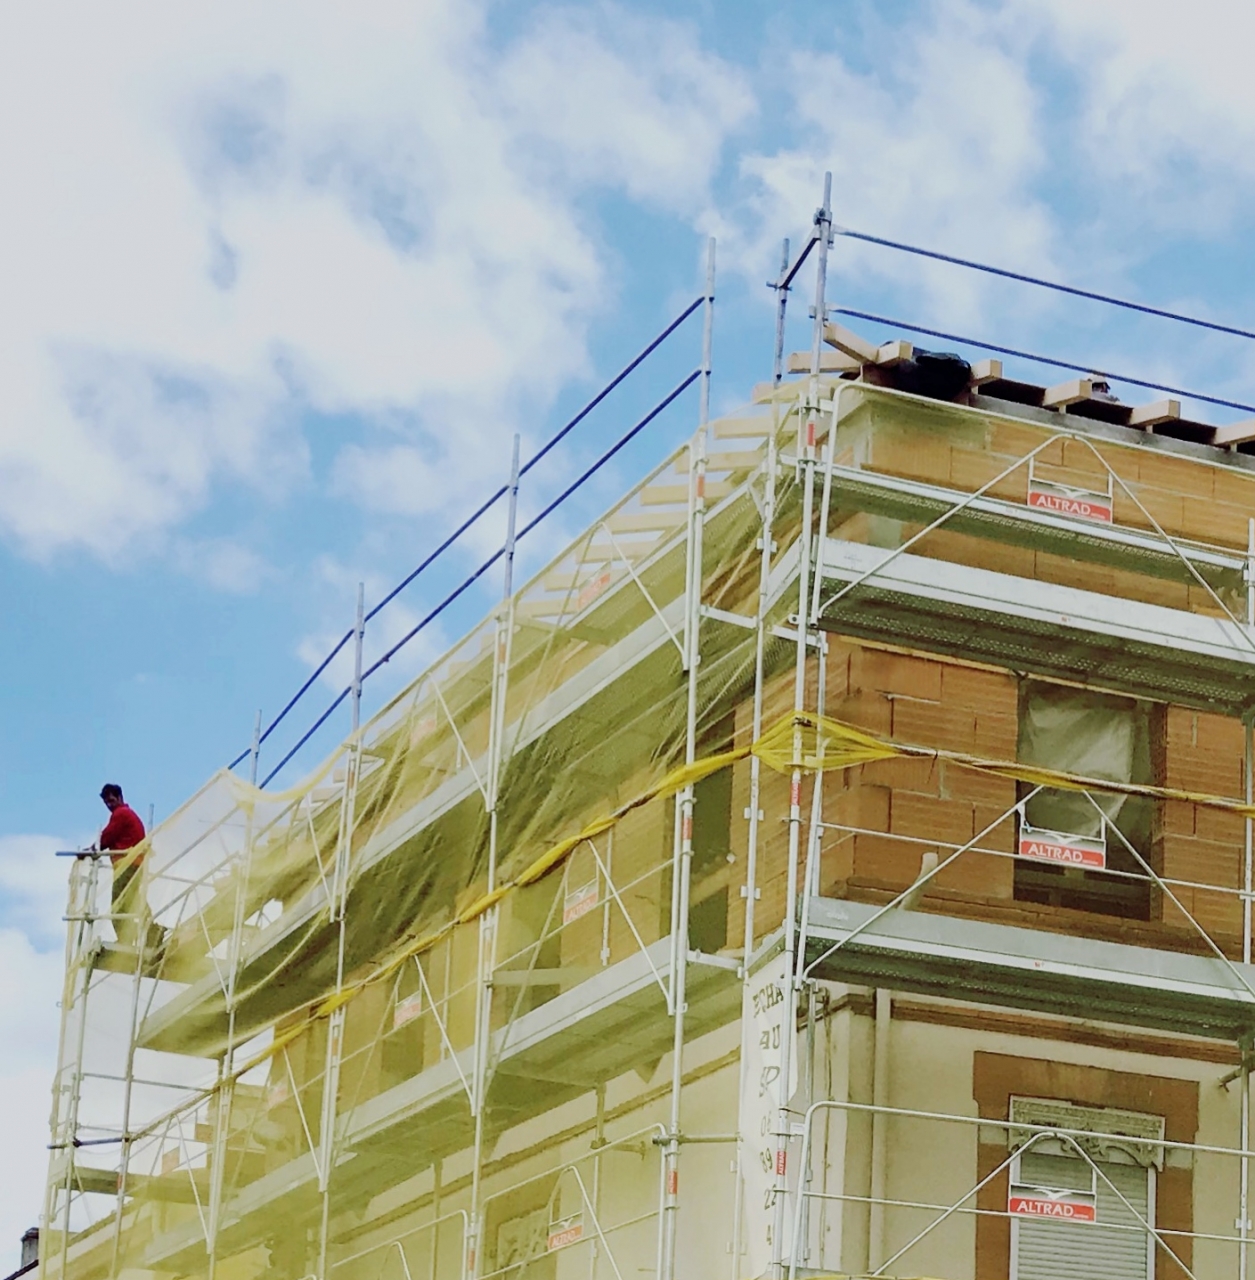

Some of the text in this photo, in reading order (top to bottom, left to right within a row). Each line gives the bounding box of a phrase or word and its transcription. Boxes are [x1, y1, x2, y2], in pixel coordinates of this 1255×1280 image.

[1037, 496, 1091, 515] ALTRAD
[1027, 842, 1083, 861] ALTRAD
[1017, 1200, 1074, 1216] ALTRAD
